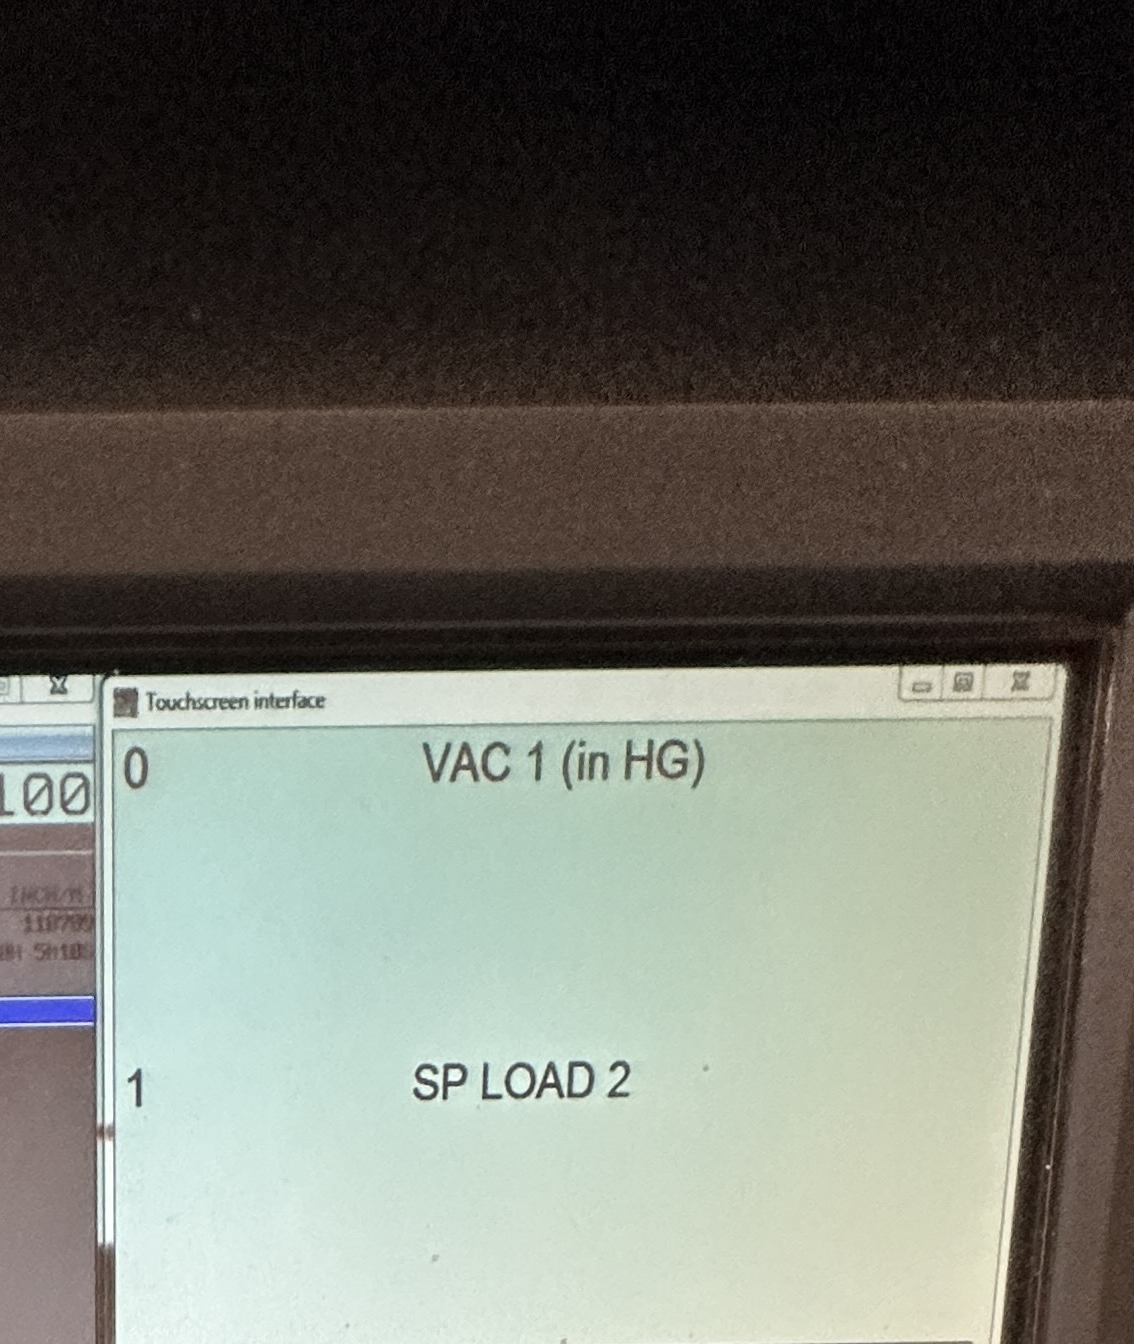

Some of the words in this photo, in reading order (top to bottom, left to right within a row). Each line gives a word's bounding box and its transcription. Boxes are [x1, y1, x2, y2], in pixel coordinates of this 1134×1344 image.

[146, 691, 249, 712] Touchscreen
[253, 689, 326, 711] interface
[123, 746, 149, 789] 0
[422, 741, 512, 784] VAC
[527, 740, 545, 782] 1
[561, 739, 610, 790] (in
[624, 738, 707, 790] HG)
[412, 1063, 467, 1102] SP
[481, 1060, 595, 1100] LOAD
[607, 1060, 631, 1099] 2
